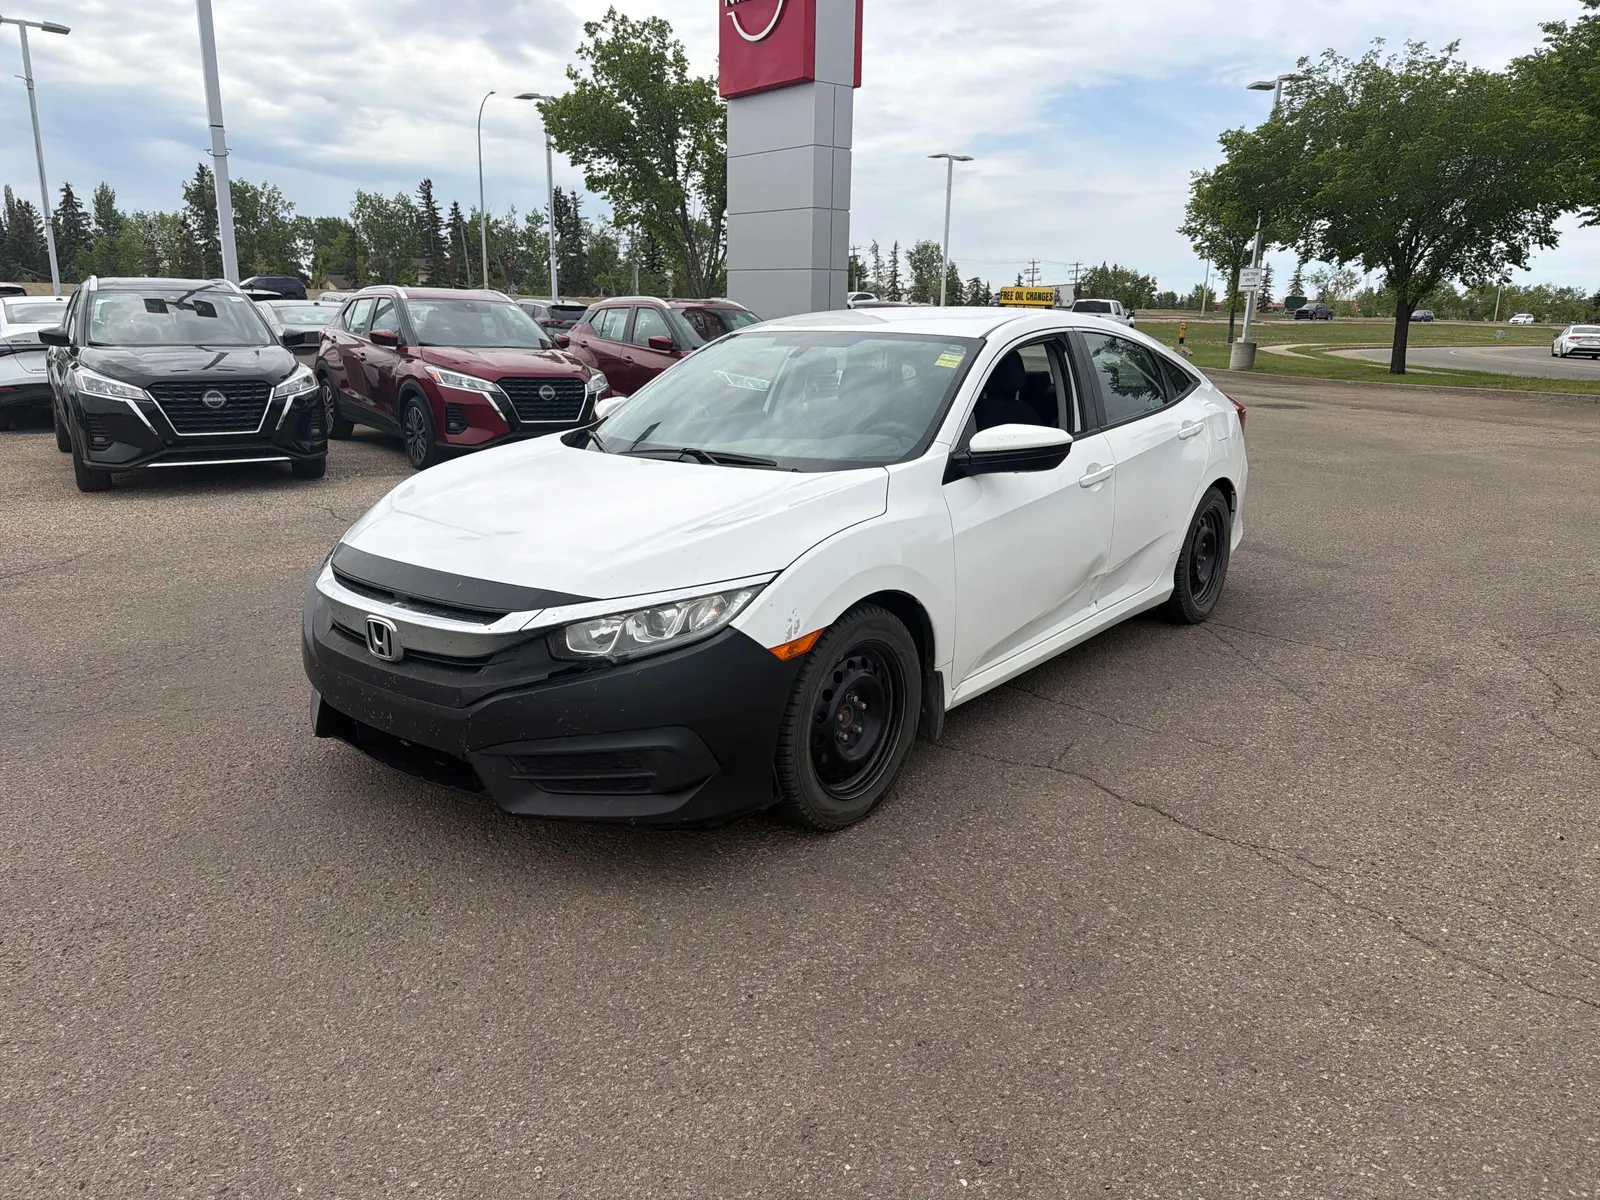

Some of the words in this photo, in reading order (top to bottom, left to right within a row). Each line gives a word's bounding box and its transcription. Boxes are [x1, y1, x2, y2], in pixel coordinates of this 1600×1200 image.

[1000, 291, 1013, 300] FREE
[1015, 291, 1024, 301] OIL
[1025, 291, 1054, 302] CHANGES
